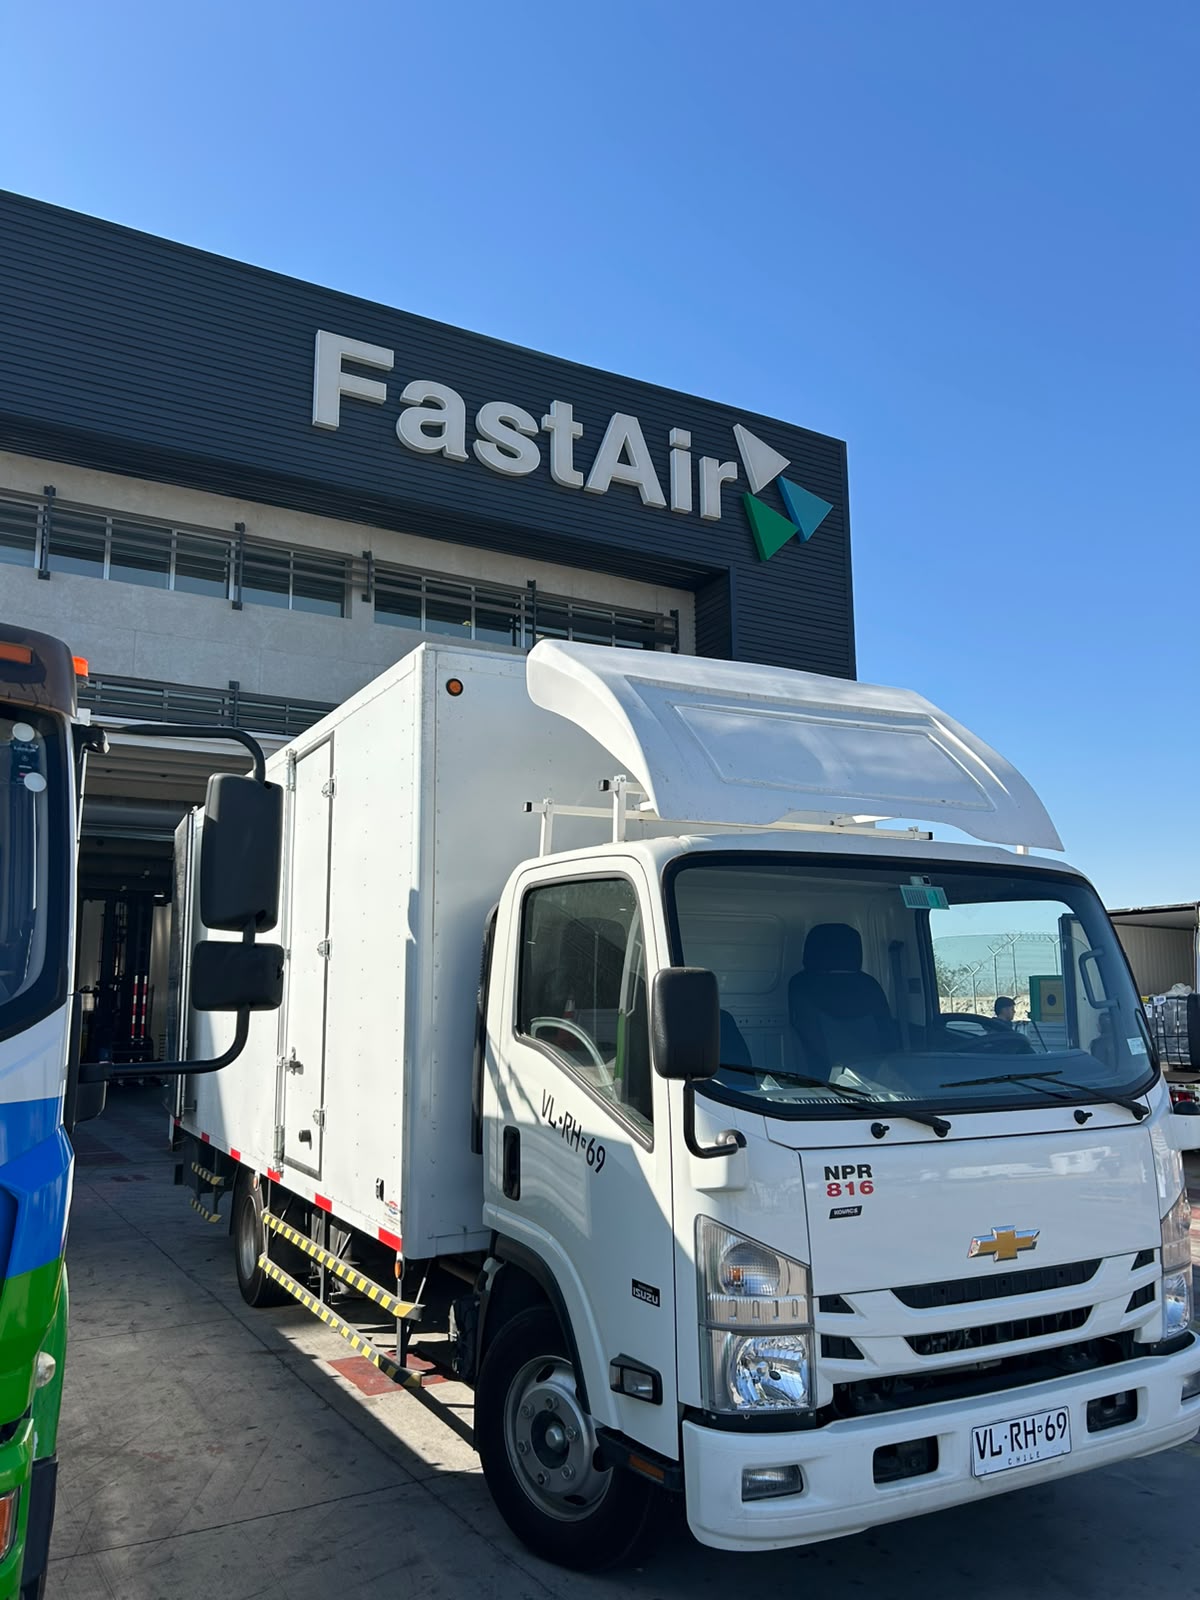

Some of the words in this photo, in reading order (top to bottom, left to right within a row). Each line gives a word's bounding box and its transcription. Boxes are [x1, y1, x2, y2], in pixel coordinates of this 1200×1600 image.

[312, 329, 738, 520] FastAir
[824, 1164, 873, 1181] NPR
[826, 1180, 875, 1198] 816
[633, 1286, 659, 1305] ISUZU
[1008, 1450, 1040, 1466] CHILE
